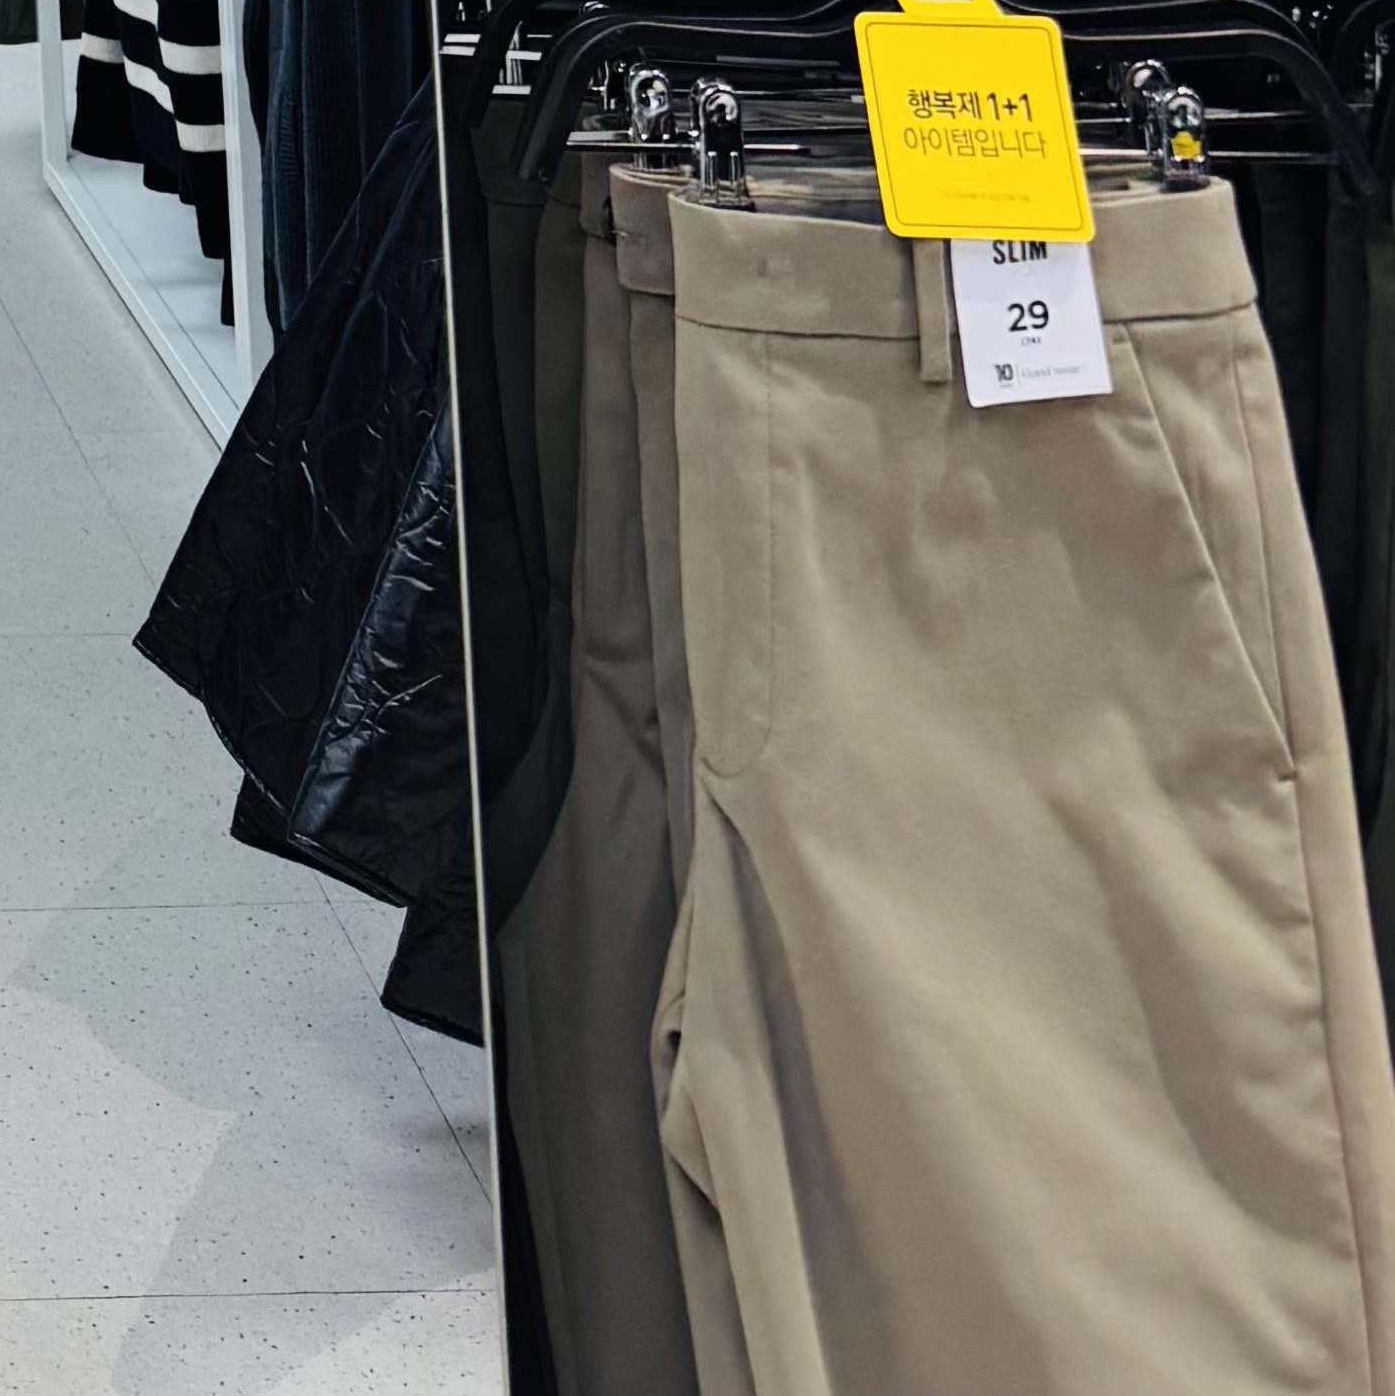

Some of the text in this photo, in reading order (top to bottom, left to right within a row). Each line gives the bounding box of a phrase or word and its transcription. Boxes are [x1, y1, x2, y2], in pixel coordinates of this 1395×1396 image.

[907, 88, 1033, 122] 행복제 1+1
[903, 127, 1046, 159] 아이템입니다
[992, 240, 1048, 265] SLIM
[1007, 300, 1049, 332] 29
